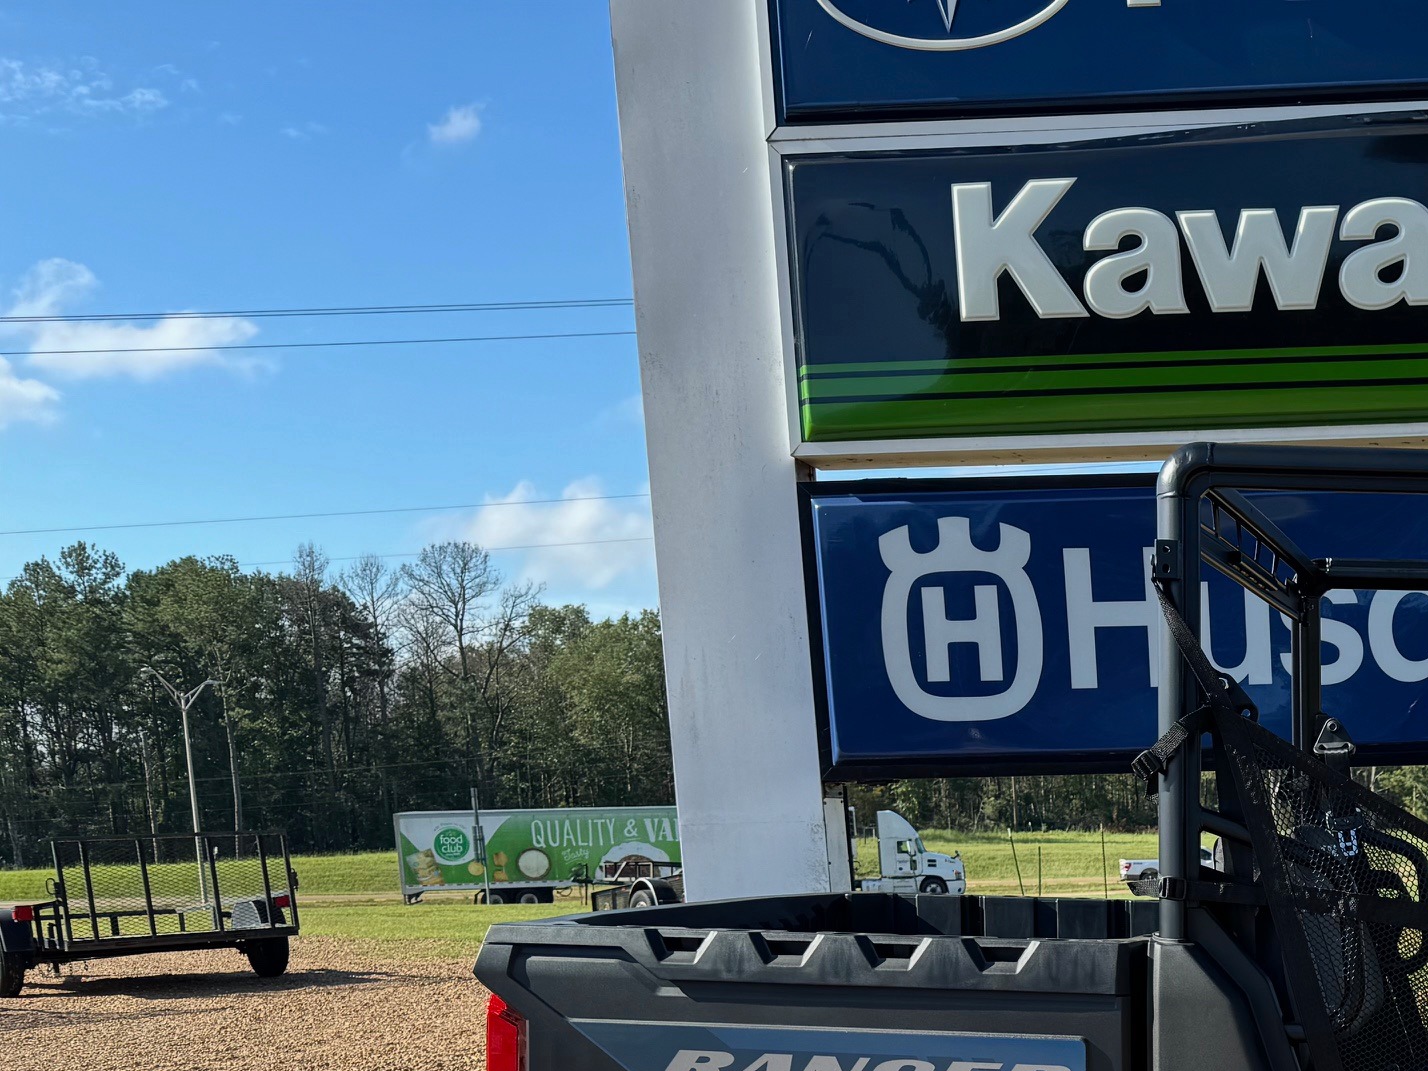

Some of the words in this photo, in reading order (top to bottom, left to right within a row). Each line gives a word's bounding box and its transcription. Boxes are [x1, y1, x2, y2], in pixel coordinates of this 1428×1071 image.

[531, 818, 615, 848] QUALITY
[624, 819, 638, 837] &
[440, 834, 463, 844] food
[441, 843, 463, 853] club
